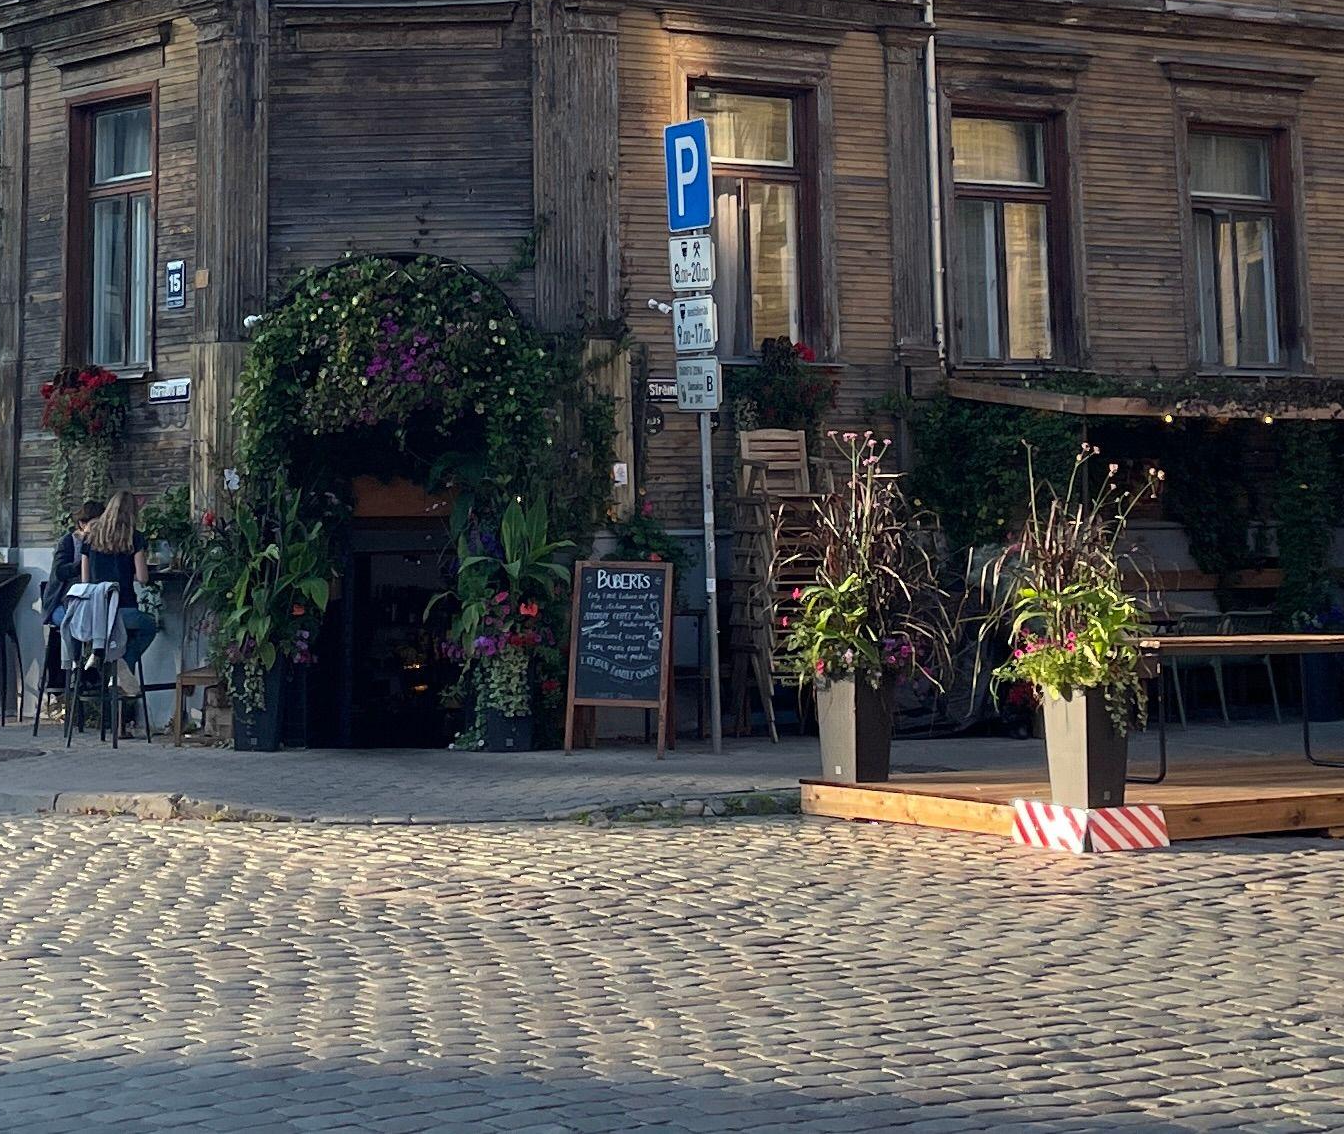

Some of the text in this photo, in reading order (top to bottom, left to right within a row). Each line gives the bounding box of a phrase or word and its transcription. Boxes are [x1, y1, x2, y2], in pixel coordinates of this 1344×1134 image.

[675, 136, 698, 216] P
[169, 273, 180, 292] 15
[677, 323, 712, 345] 9.00-17.00
[706, 376, 713, 391] B
[597, 569, 651, 590] BUBERTS
